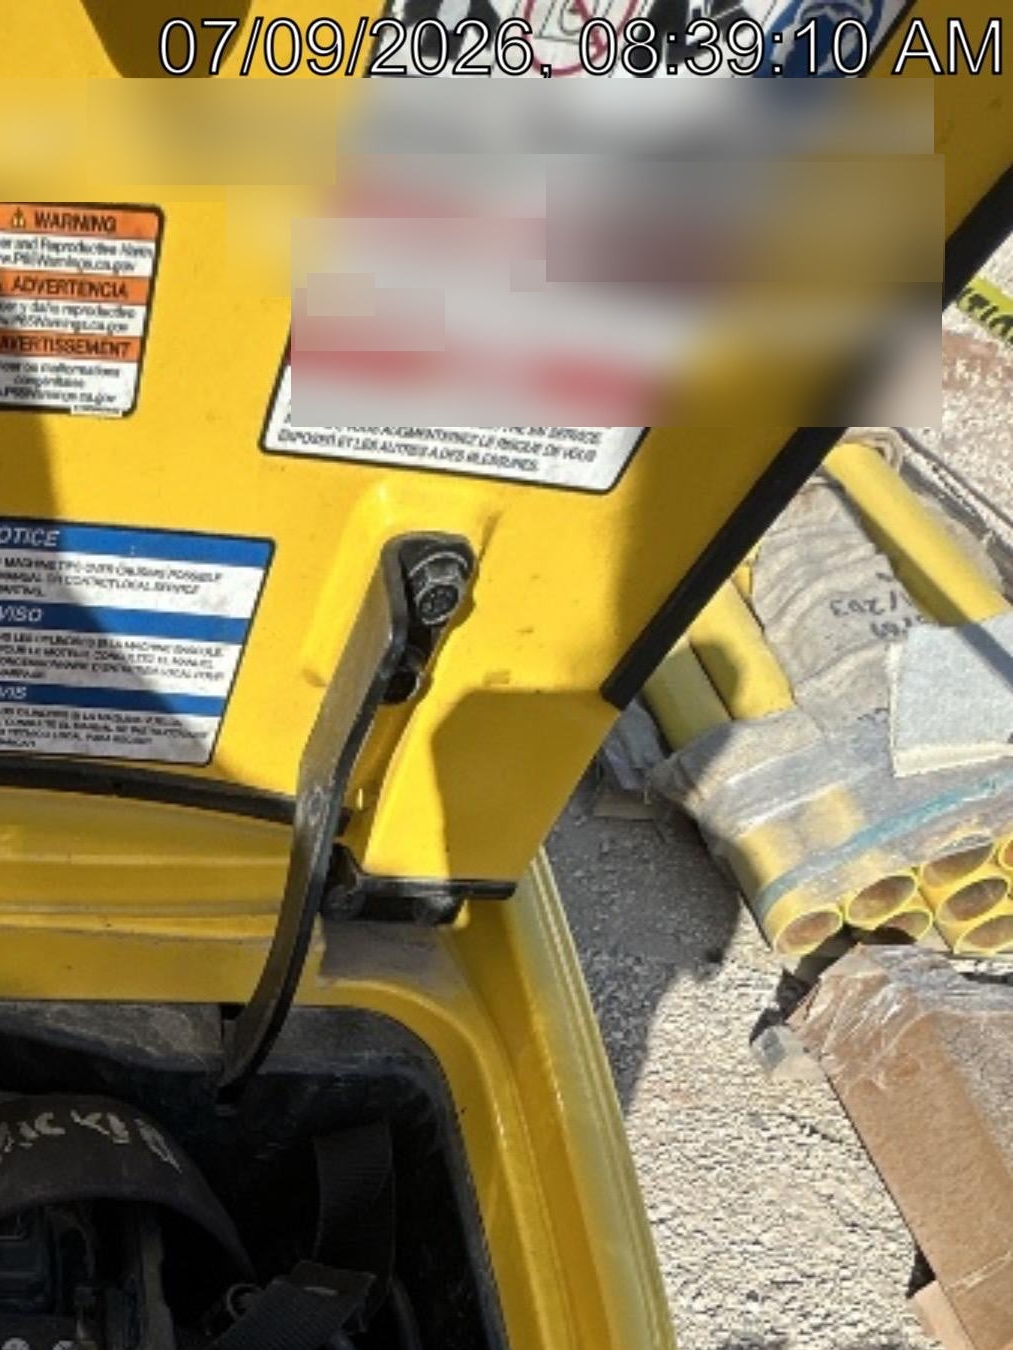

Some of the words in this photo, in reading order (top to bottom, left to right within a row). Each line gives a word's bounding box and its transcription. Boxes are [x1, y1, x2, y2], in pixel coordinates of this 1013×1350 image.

[34, 208, 117, 232] WARNING
[14, 235, 38, 250] and
[41, 237, 117, 257] Reproductive
[11, 279, 129, 299] ADVERTENCIA
